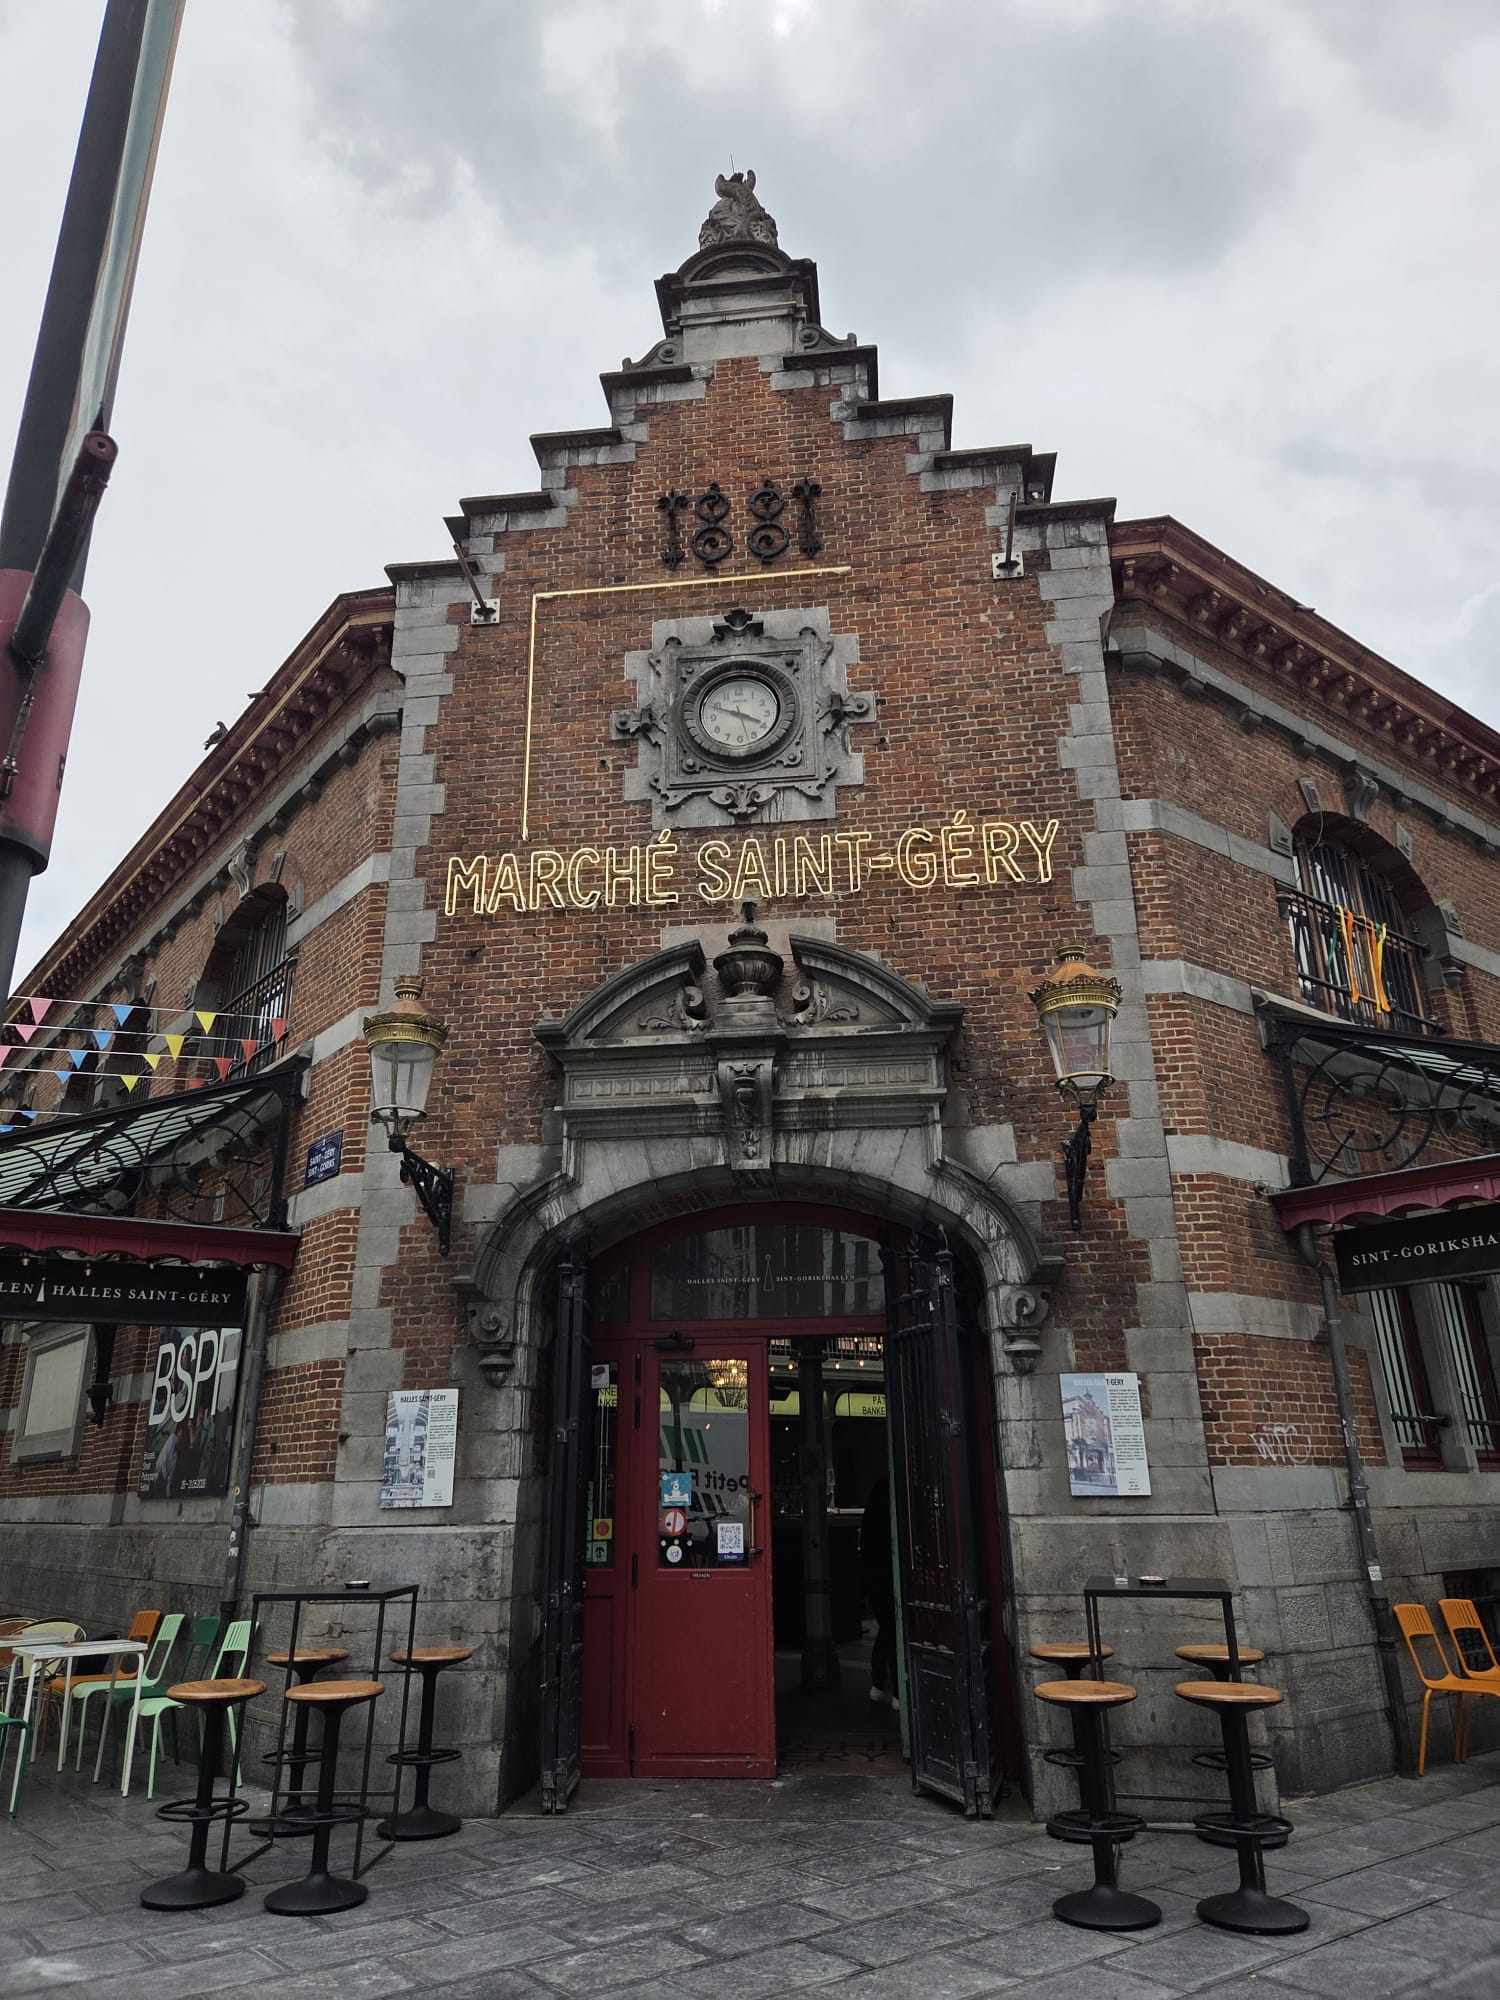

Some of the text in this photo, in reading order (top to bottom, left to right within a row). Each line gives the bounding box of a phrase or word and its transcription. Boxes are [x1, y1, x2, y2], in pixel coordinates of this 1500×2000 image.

[658, 476, 822, 570] 1881
[445, 809, 1060, 916] MARCHÉ SAINT-GÉRY
[52, 1284, 231, 1304] HALLES SAINT-GÉRY
[1352, 1232, 1500, 1266] SINT-GORIKSHA
[149, 1327, 242, 1426] BSPF
